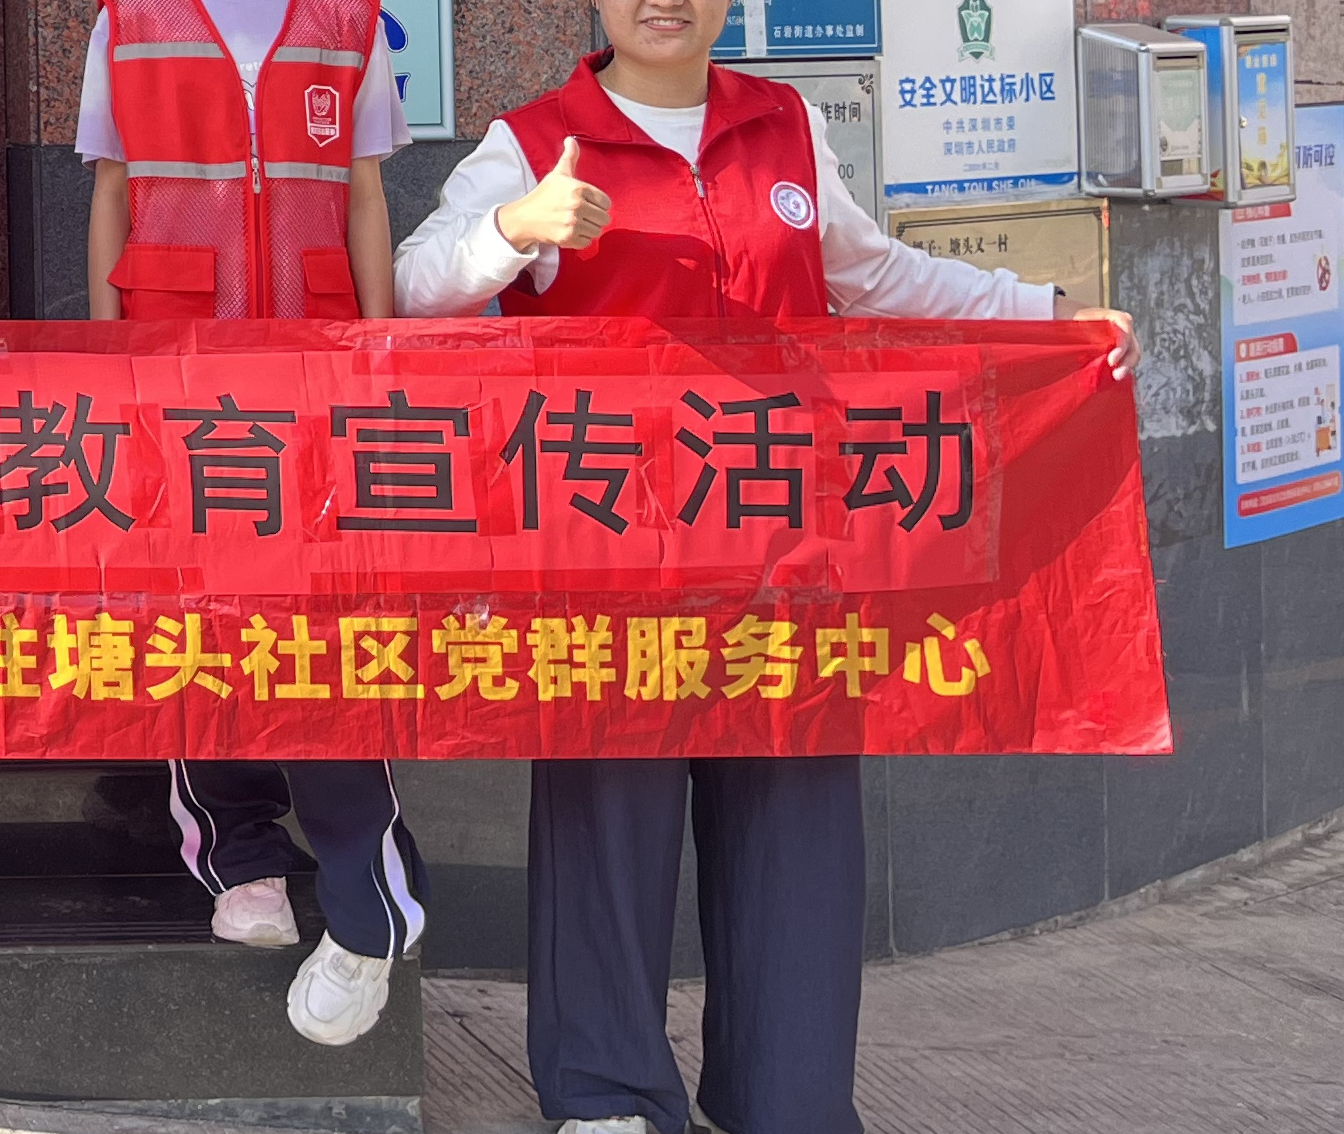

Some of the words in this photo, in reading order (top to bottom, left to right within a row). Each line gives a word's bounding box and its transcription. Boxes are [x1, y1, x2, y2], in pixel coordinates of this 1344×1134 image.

[897, 71, 1056, 109] 安全文明达标小区
[814, 101, 861, 123] 作时间
[943, 138, 1016, 156] 深圳市人民政府
[925, 182, 959, 198] TANG
[991, 179, 1014, 192] SHE
